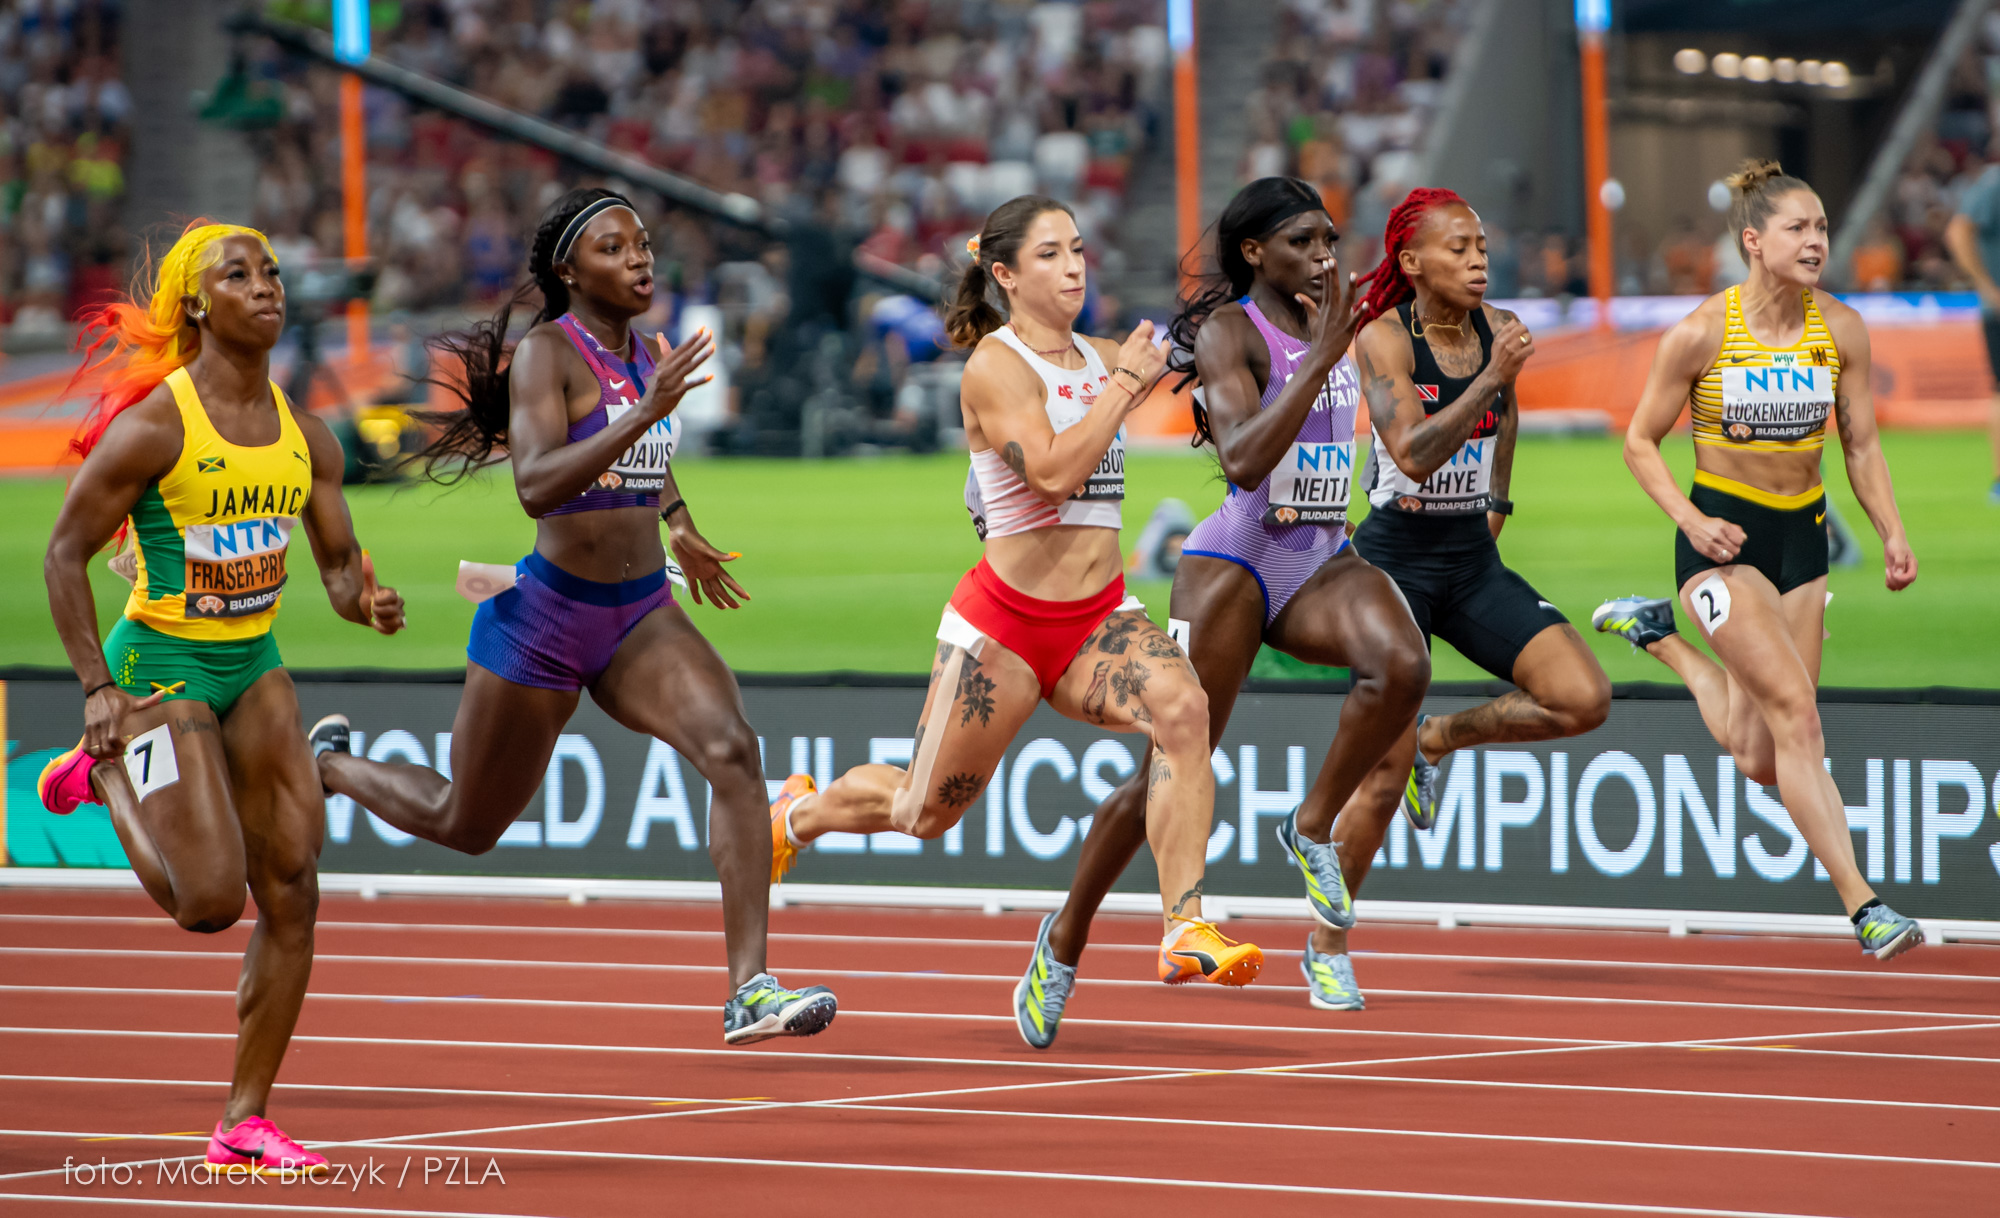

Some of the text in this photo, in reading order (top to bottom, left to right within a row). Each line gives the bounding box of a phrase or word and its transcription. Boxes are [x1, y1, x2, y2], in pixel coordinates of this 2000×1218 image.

[1745, 368, 1815, 392] NTN
[1727, 398, 1829, 421] LÜCKENKEMPER
[1755, 426, 1808, 435] BUDAPEST
[1297, 444, 1350, 472] NTN
[1418, 470, 1477, 494] AHYE
[1425, 498, 1486, 510] BUDAPEST 23
[213, 517, 284, 557] NTN
[1700, 588, 1721, 622] 2
[134, 739, 154, 785] 7
